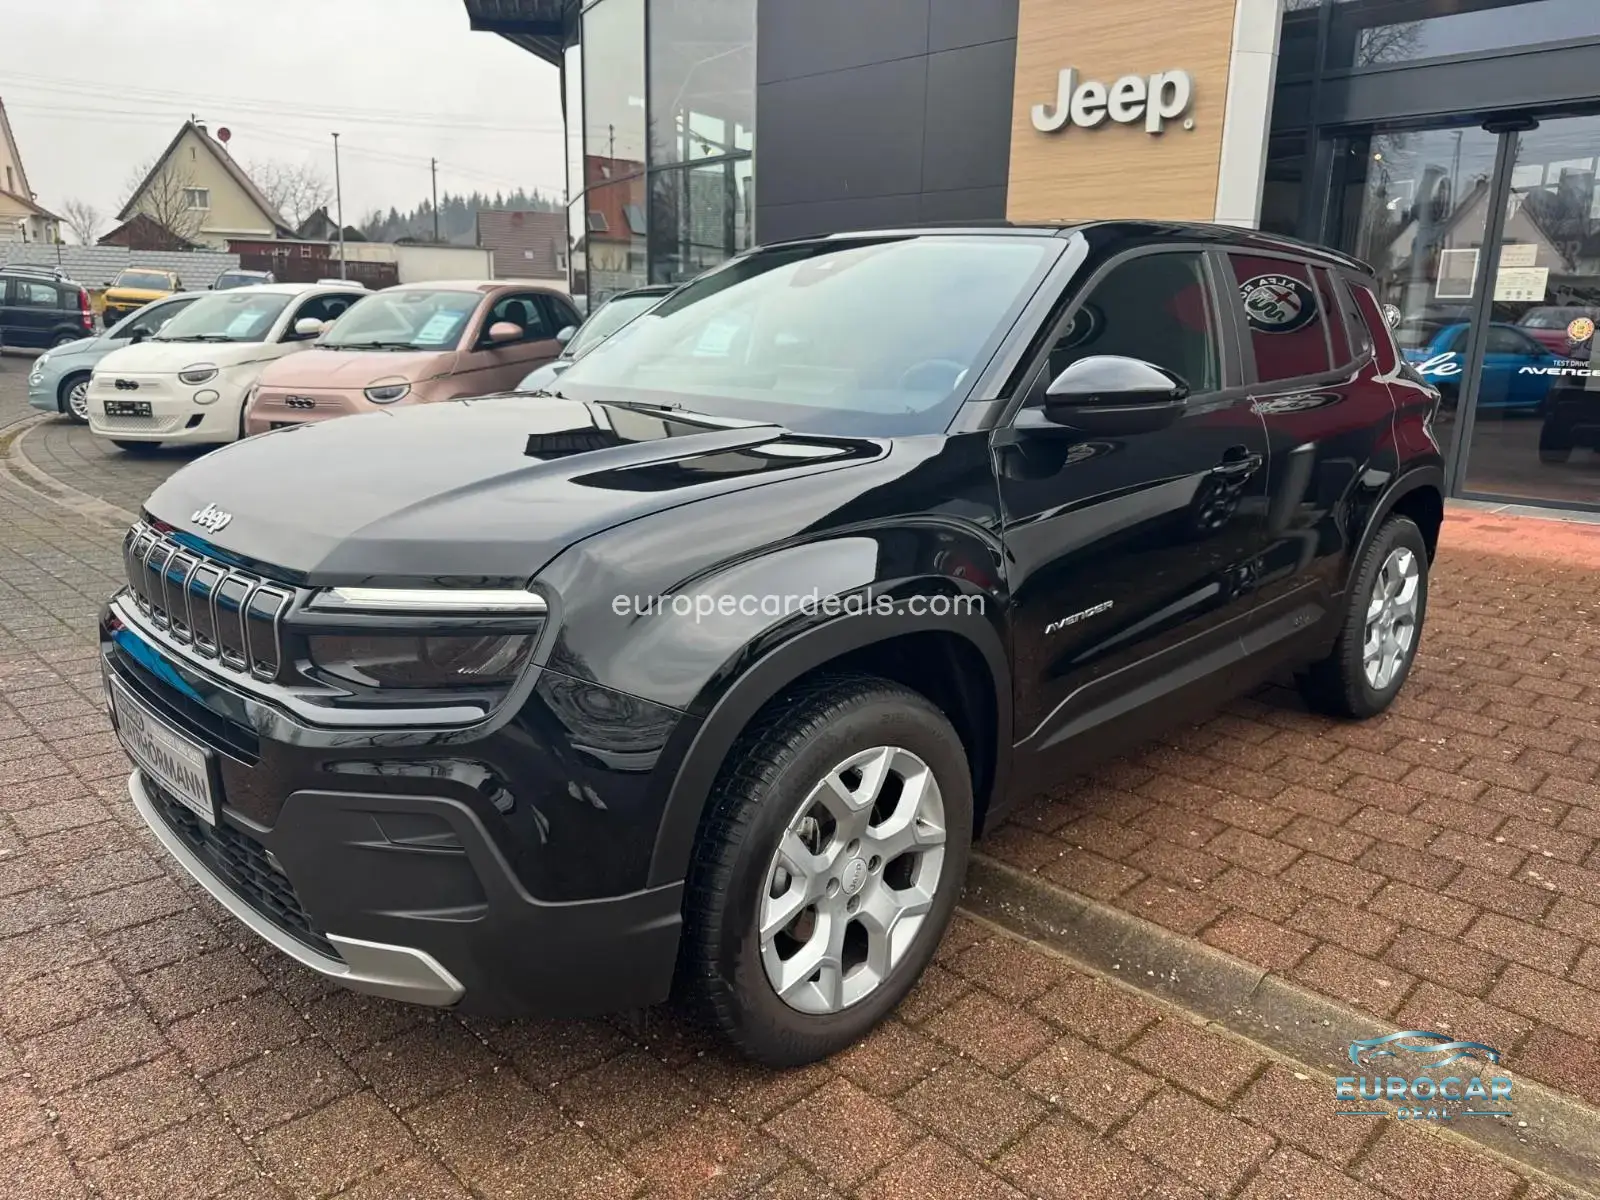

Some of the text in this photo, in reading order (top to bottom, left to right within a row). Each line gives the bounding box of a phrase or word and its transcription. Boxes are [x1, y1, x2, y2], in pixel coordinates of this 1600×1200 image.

[1031, 67, 1191, 133] Jeep
[1553, 359, 1590, 368] TEST DRIVE
[191, 502, 232, 534] Jeep
[1045, 600, 1114, 634] AVENGER
